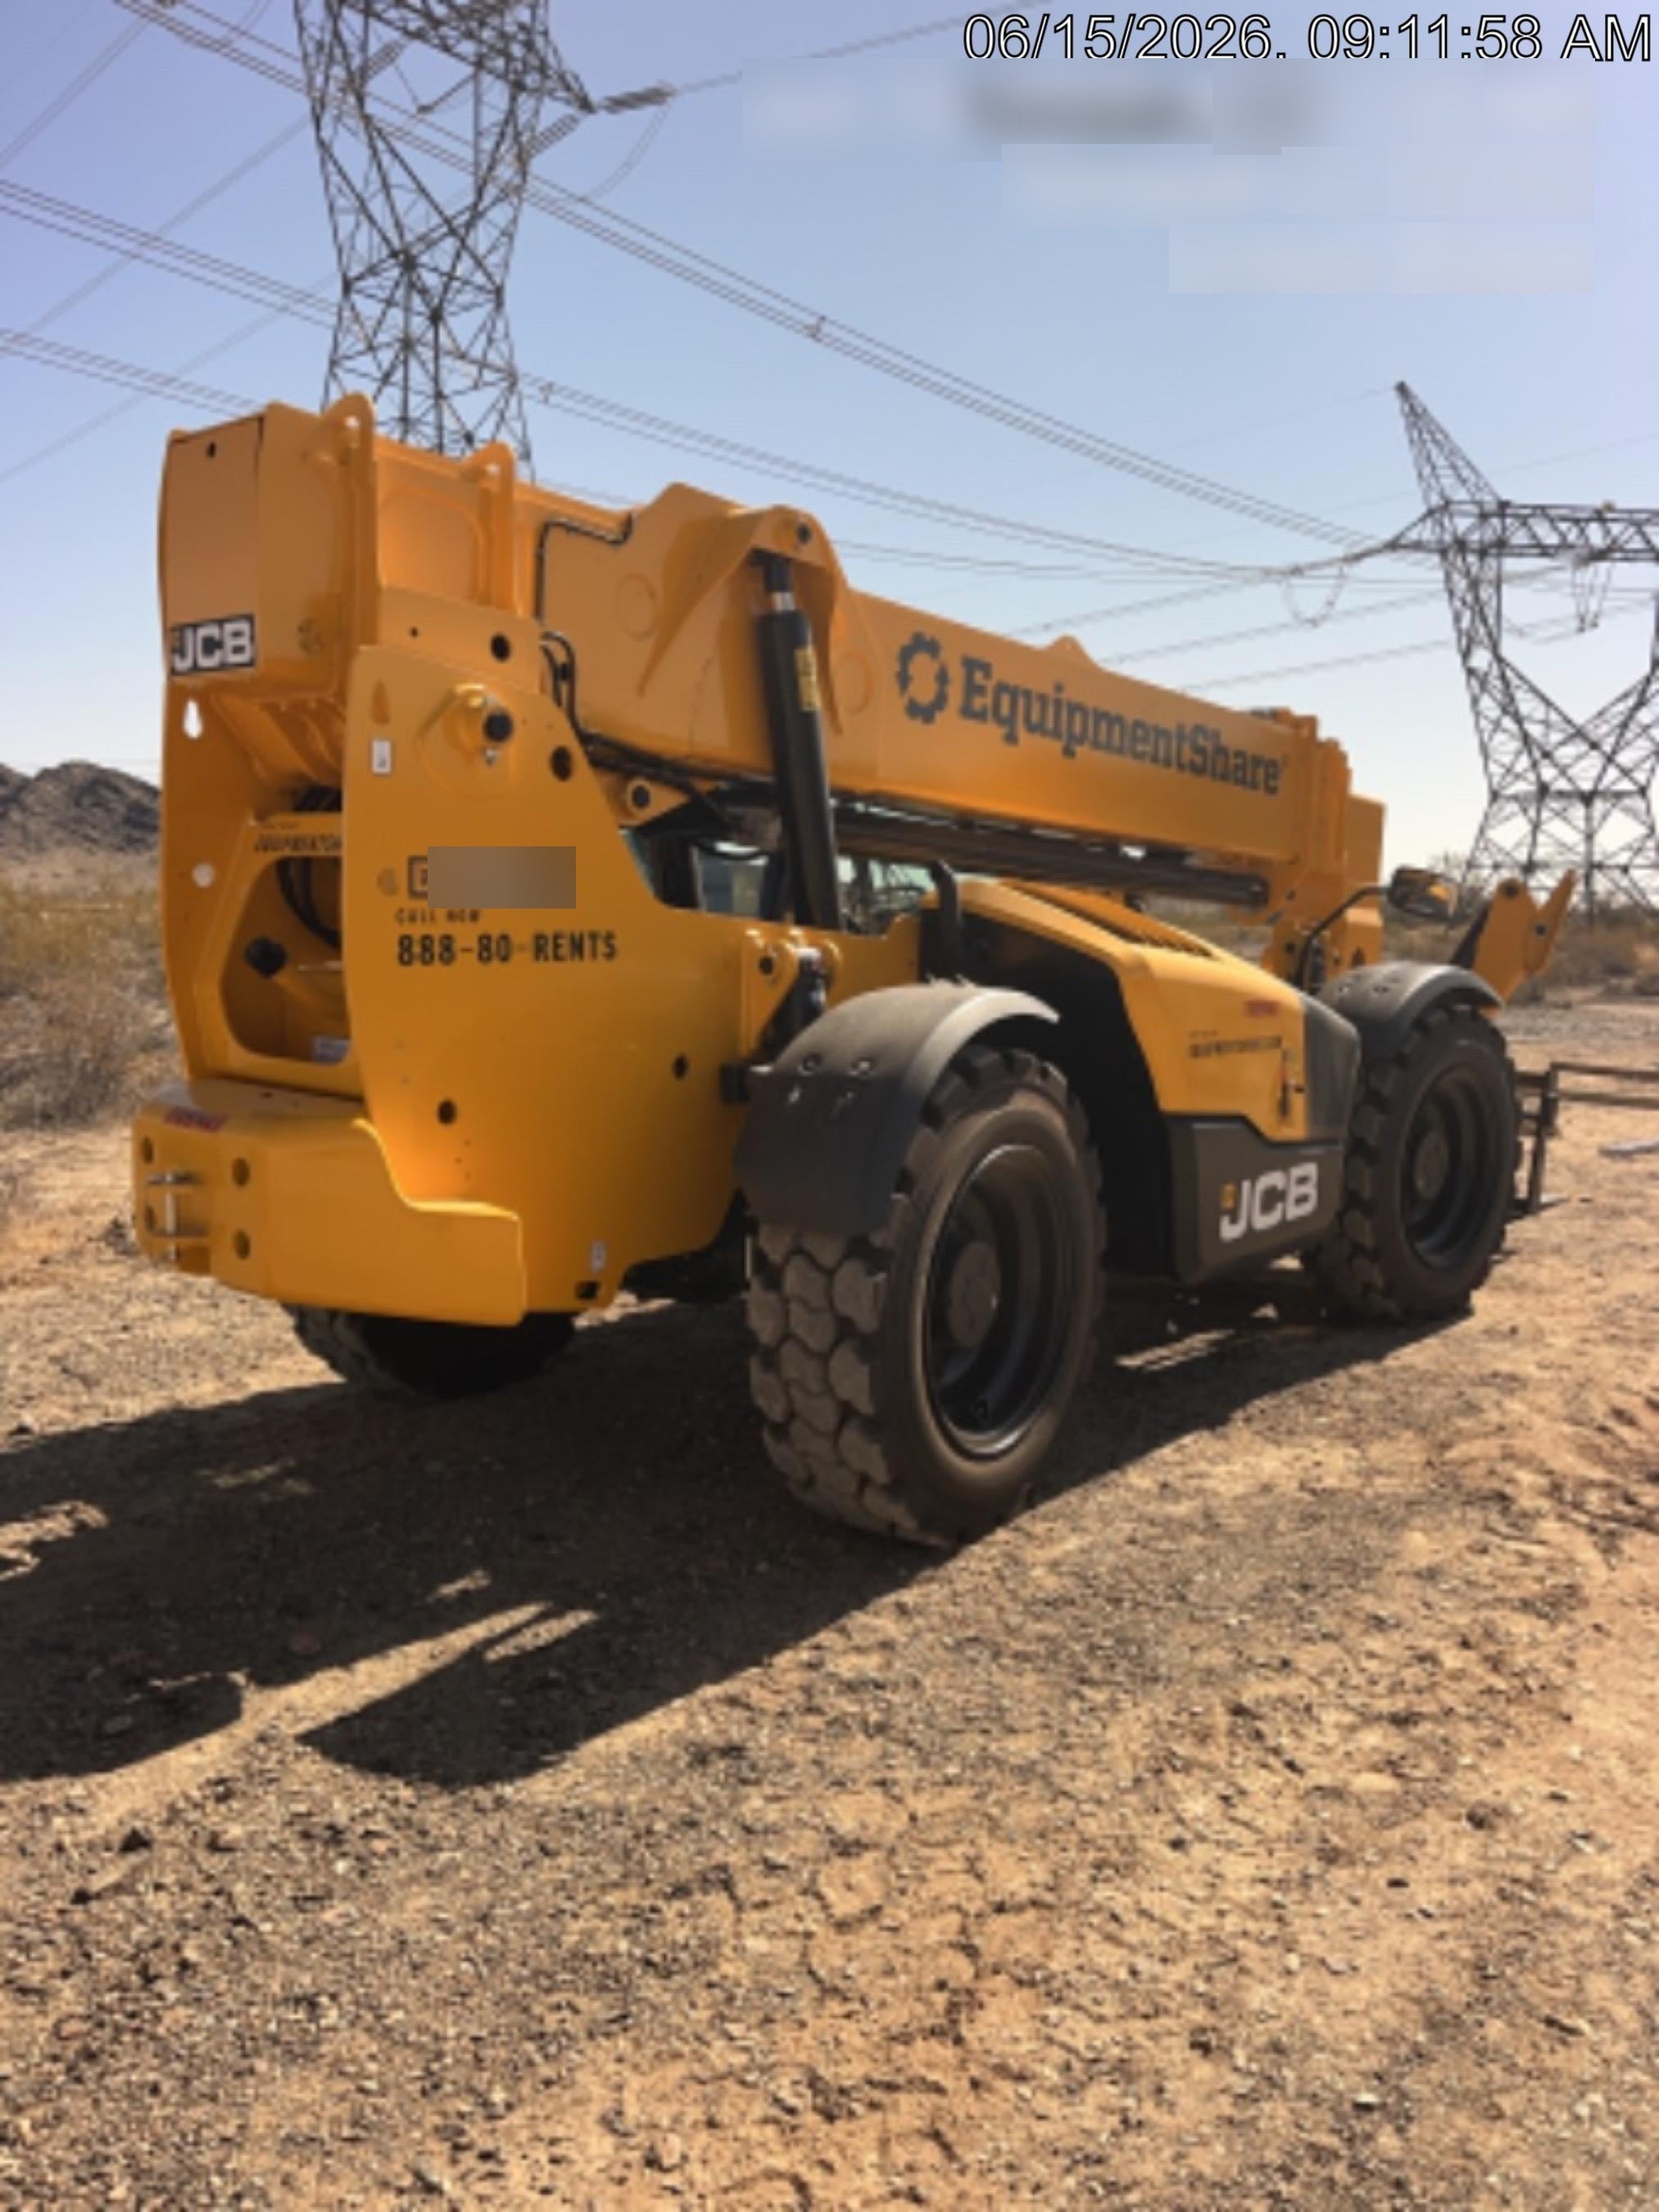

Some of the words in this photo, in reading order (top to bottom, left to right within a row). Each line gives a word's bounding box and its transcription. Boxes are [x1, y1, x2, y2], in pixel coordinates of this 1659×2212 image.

[173, 619, 252, 673] JCB
[959, 655, 1281, 795] EquipmentShare
[1219, 1162, 1318, 1241] JCB
